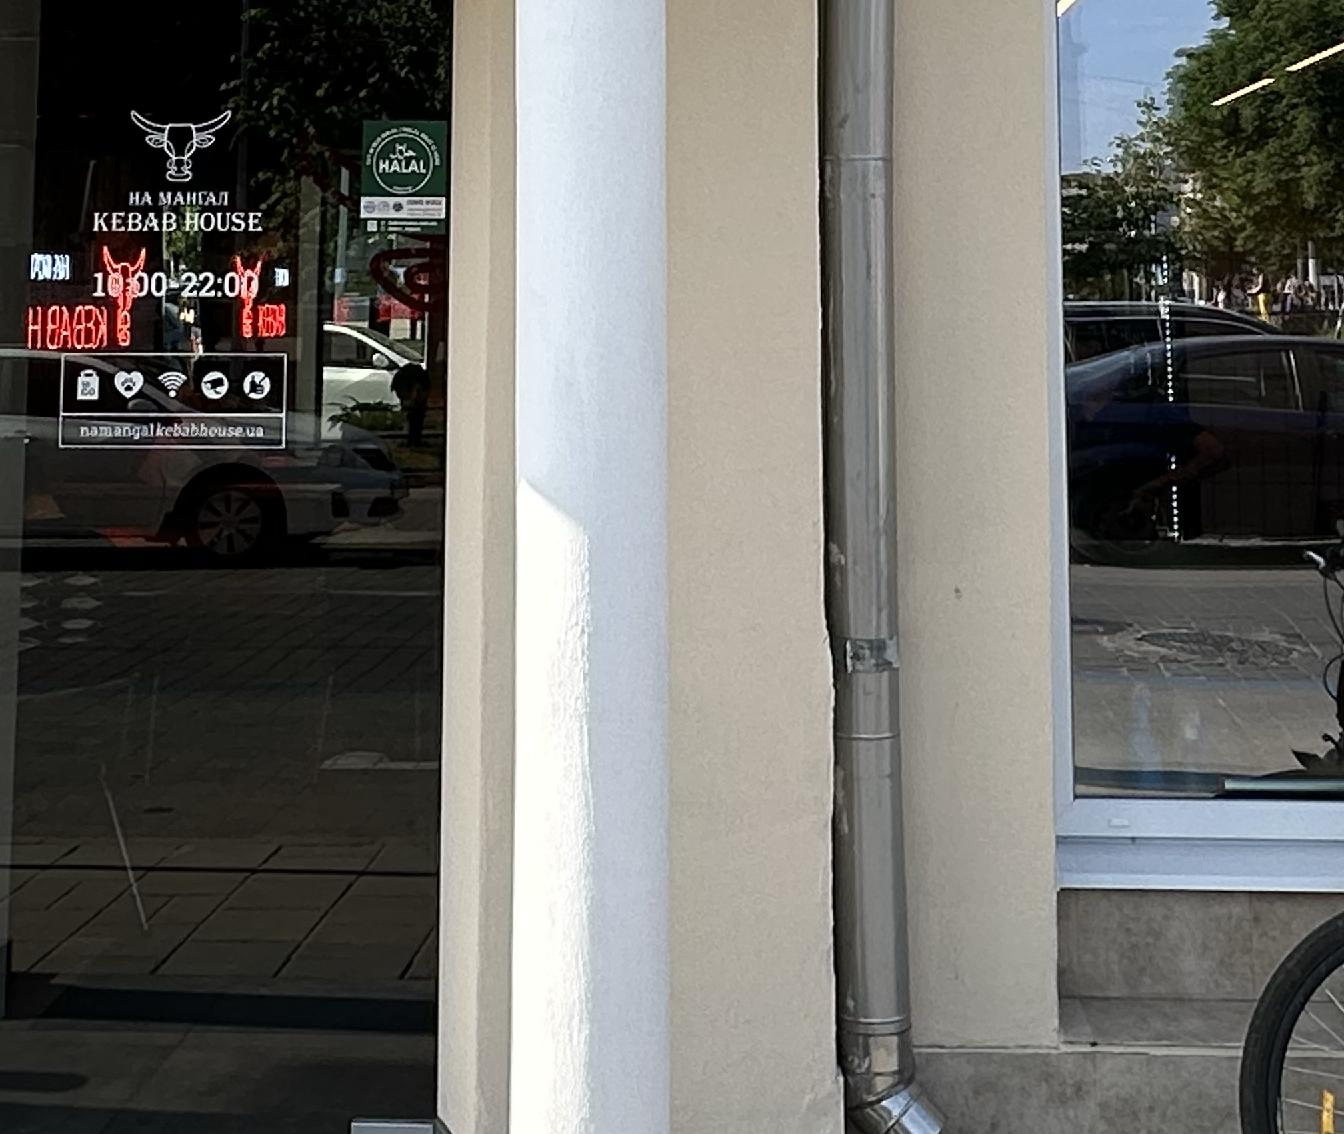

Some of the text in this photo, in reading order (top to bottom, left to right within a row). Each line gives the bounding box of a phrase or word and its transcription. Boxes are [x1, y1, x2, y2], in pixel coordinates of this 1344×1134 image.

[378, 159, 426, 174] HALAL
[128, 191, 229, 206] НА МАНГАЛ
[92, 212, 264, 232] KEBAB HOUSE
[80, 422, 265, 440] namangalkebabhouse.ua
